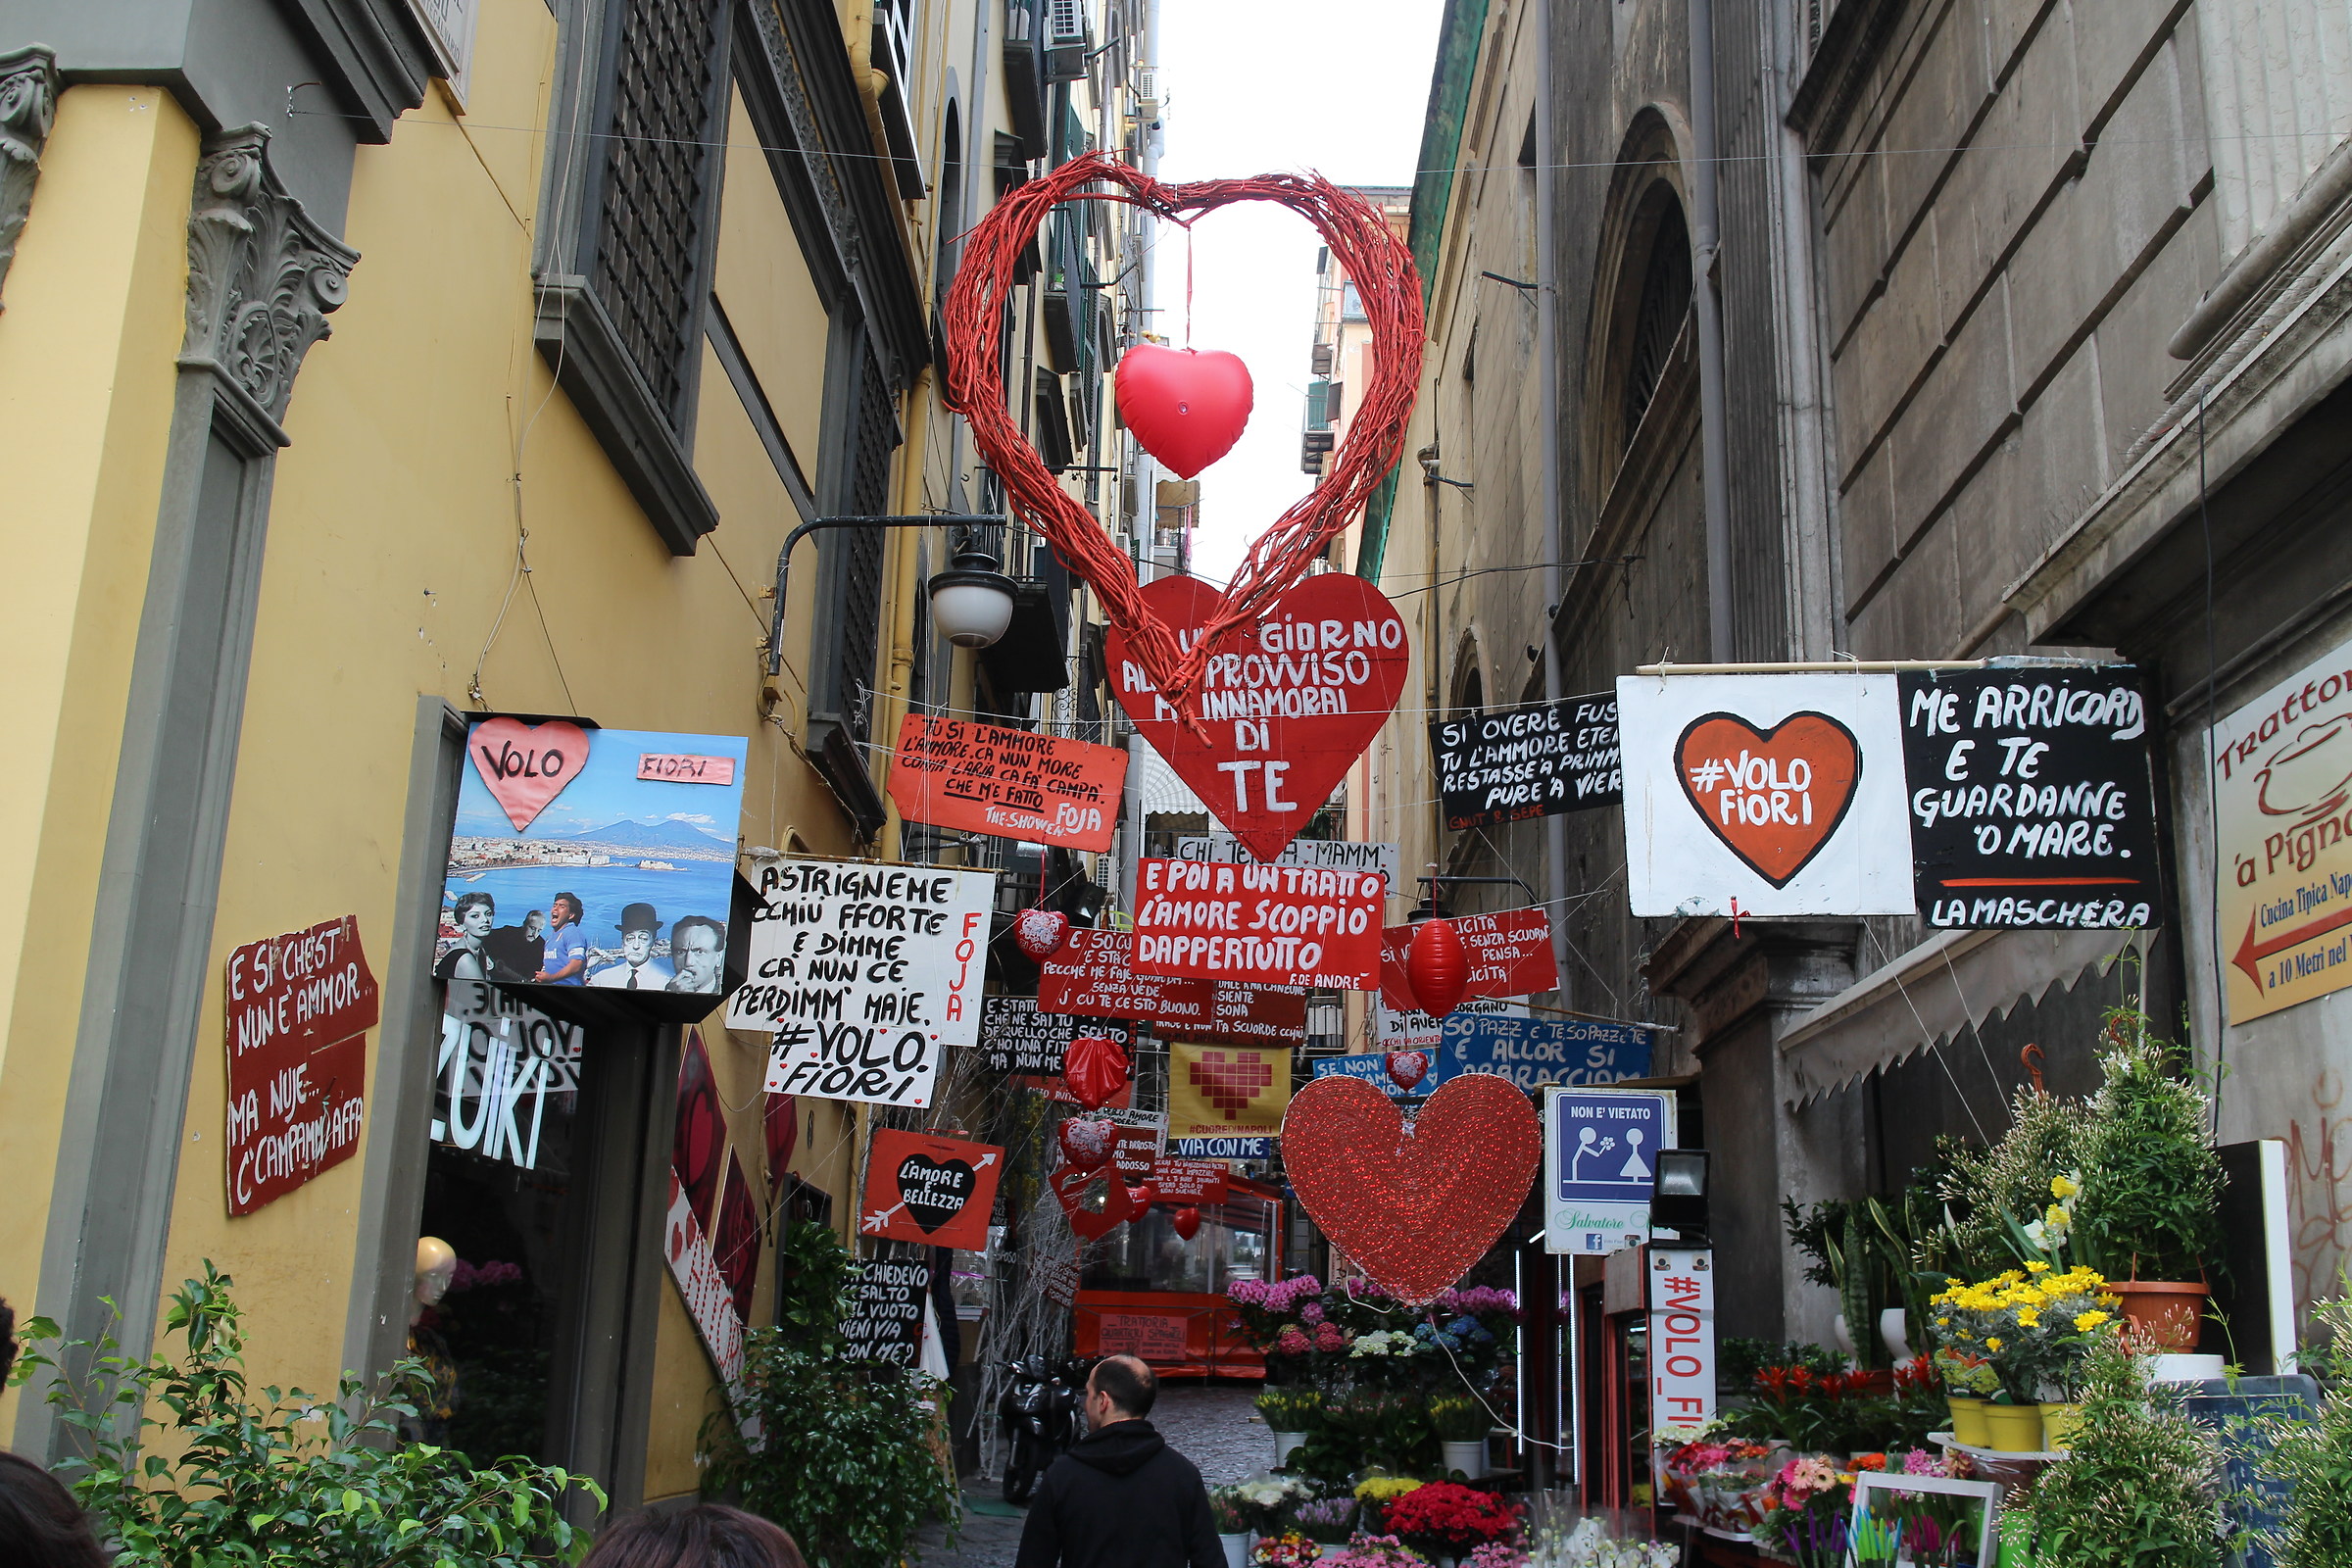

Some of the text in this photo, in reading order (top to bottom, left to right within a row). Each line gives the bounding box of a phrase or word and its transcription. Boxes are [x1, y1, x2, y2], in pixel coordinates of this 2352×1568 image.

[1259, 613, 1401, 654] GIORNO
[1910, 688, 1959, 736] ME
[947, 721, 964, 740] SI
[975, 725, 1055, 756] L'AMMORE
[1235, 718, 1270, 752] DI
[1442, 723, 1467, 747] SI
[481, 740, 564, 781] VOLO
[642, 758, 707, 777] FIORI
[975, 747, 1083, 780] CA NUN MORE
[1441, 732, 1570, 773] TU L'AMMORE
[1945, 737, 2049, 781] E TE
[1000, 769, 1020, 783] CA
[1217, 760, 1298, 812] TE
[1444, 760, 1535, 793] RESTASSE
[1690, 750, 1811, 793] #VOLO
[946, 777, 972, 794] CHE
[1006, 786, 1043, 808] FATTO
[1486, 781, 1543, 809] PURE
[1720, 789, 1813, 826] FIORI
[1913, 781, 2126, 828] GUARDANNE
[1055, 803, 1102, 833] FOJA
[1449, 812, 1486, 829] GNUT
[1512, 804, 1544, 820] SEPE
[1180, 838, 1214, 863] CHI
[760, 864, 953, 905] ASTRIGNEME
[1147, 862, 1163, 890] E
[1167, 860, 1211, 893] POI
[1216, 867, 1234, 894] A
[1243, 864, 1280, 893] UN
[1283, 868, 1380, 899] TRATTO
[838, 903, 949, 936] FFORTE
[1138, 893, 1242, 930] L'AMORE
[1932, 897, 2150, 927] LA MASCHERA
[2261, 896, 2294, 929] Cucina
[2296, 880, 2328, 915] Tipica
[793, 930, 907, 960] E DIMME
[1069, 931, 1083, 948] E
[1139, 934, 1323, 971] DAPPERTUTTO
[1380, 946, 1396, 962] SI
[1469, 932, 1505, 948] SENZA
[231, 926, 341, 1002] E SI CHEST
[807, 958, 909, 984] NUN CE
[946, 912, 982, 1022] FOJA
[1090, 965, 1105, 981] ME
[2269, 971, 2276, 989] a
[2279, 958, 2293, 984] 10
[2295, 946, 2326, 980] Metri
[2328, 936, 2346, 963] nel
[1077, 994, 1096, 1005] CU
[1099, 995, 1112, 1007] TE
[1115, 996, 1130, 1008] CE
[1134, 997, 1156, 1011] STO
[1091, 982, 1127, 994] SENZA
[1217, 990, 1254, 1004] SIENTE
[986, 999, 999, 1014] E
[1012, 1013, 1026, 1025] NE
[1030, 1014, 1053, 1027] SAI
[1057, 1015, 1074, 1028] TU
[1215, 1004, 1249, 1017] SONA
[237, 997, 274, 1057] NUN
[1049, 1027, 1073, 1040] CHE
[1232, 1019, 1277, 1036] SCUORDE
[1389, 1019, 1404, 1032] DI
[1479, 1018, 1523, 1038] PAZZ
[1530, 1025, 1540, 1039] E
[1588, 1025, 1620, 1043] PAZZ
[1015, 1039, 1042, 1053] UNA
[1454, 1038, 1616, 1069] E ALLOR SI
[990, 1054, 1007, 1070] MA
[1045, 1055, 1061, 1072] ME
[1318, 1058, 1379, 1077] SE NON
[782, 1060, 915, 1102] FIORI
[230, 1088, 260, 1148] MA
[1129, 1110, 1159, 1123] AMORE
[1571, 1105, 1593, 1119] NON
[1608, 1106, 1651, 1120] VIETATO
[1179, 1138, 1264, 1156] VIA CON ME
[899, 1159, 964, 1189] L'AMORE
[1116, 1160, 1150, 1171] ADDOSSO
[903, 1189, 964, 1211] BELLEZZA
[1554, 1207, 1624, 1230] Salvatore
[862, 1260, 929, 1287] CHIEDEVO
[859, 1285, 909, 1301] SALTO
[870, 1303, 918, 1320] VUOTO
[839, 1318, 901, 1340] VIENI VIA
[1657, 1276, 1703, 1429] #VOLO_FI
